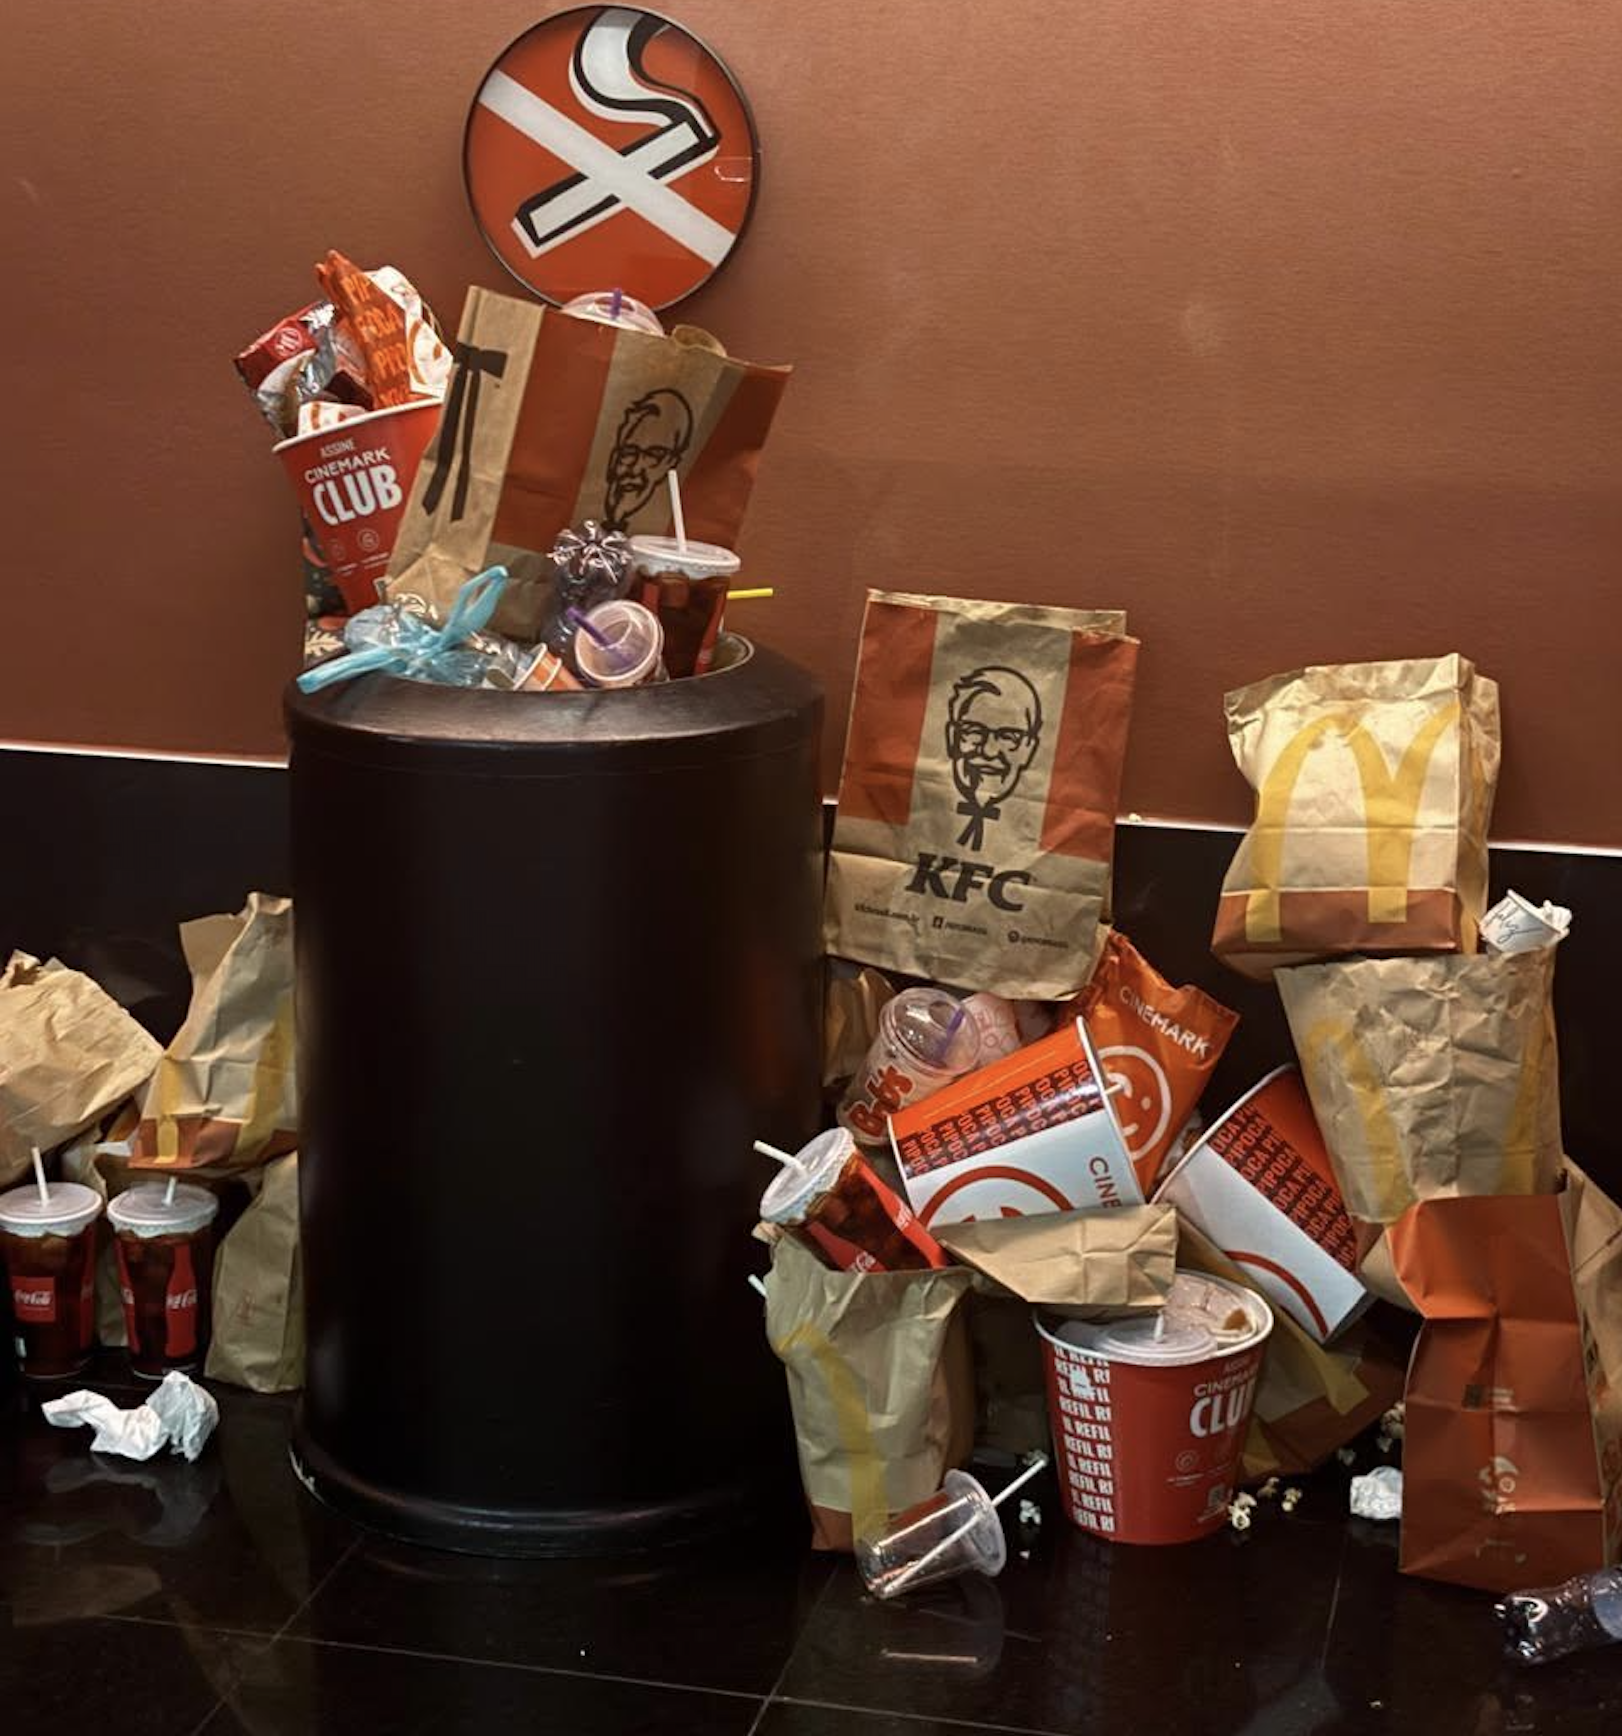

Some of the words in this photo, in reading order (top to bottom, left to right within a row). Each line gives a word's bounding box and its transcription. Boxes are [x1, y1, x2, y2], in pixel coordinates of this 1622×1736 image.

[304, 448, 391, 484] CINEMARK
[313, 465, 402, 525] CLUB
[905, 852, 1031, 912] KFC
[1120, 987, 1209, 1059] CINEMARK
